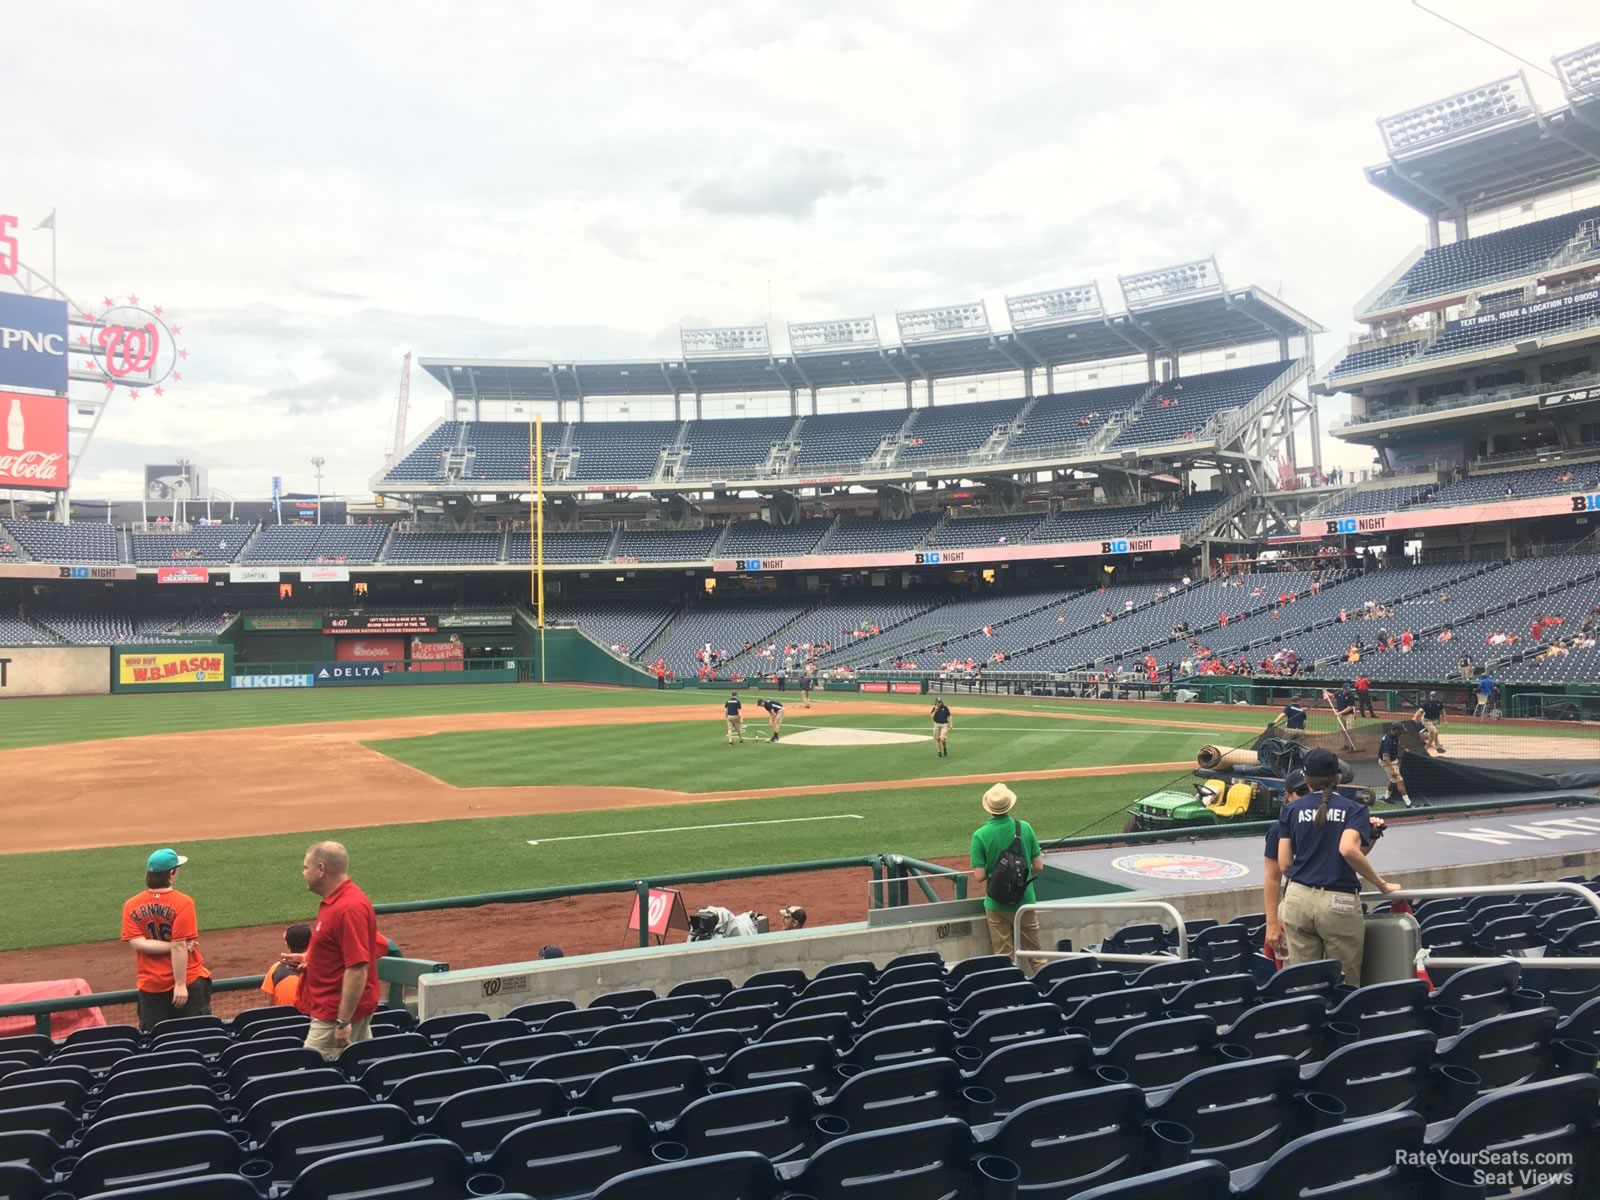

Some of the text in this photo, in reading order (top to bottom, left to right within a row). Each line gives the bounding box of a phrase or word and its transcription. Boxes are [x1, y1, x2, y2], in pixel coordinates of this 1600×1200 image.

[1460, 290, 1599, 327] TEXT NATS, ISSUE & LOCATION TO 69050
[1, 327, 64, 356] PNC
[0, 450, 63, 480] a-Cola
[1359, 517, 1386, 531] NIGHT
[1130, 540, 1153, 551] NIGHT
[943, 552, 965, 562] NIGHT
[763, 560, 784, 569] NIGHT
[91, 568, 117, 579] NIGHT
[332, 619, 348, 627] 6:07
[125, 657, 157, 666] WHO BUT
[334, 667, 380, 677] DELTA
[253, 674, 307, 687] KOCH
[1327, 808, 1346, 822] ME!
